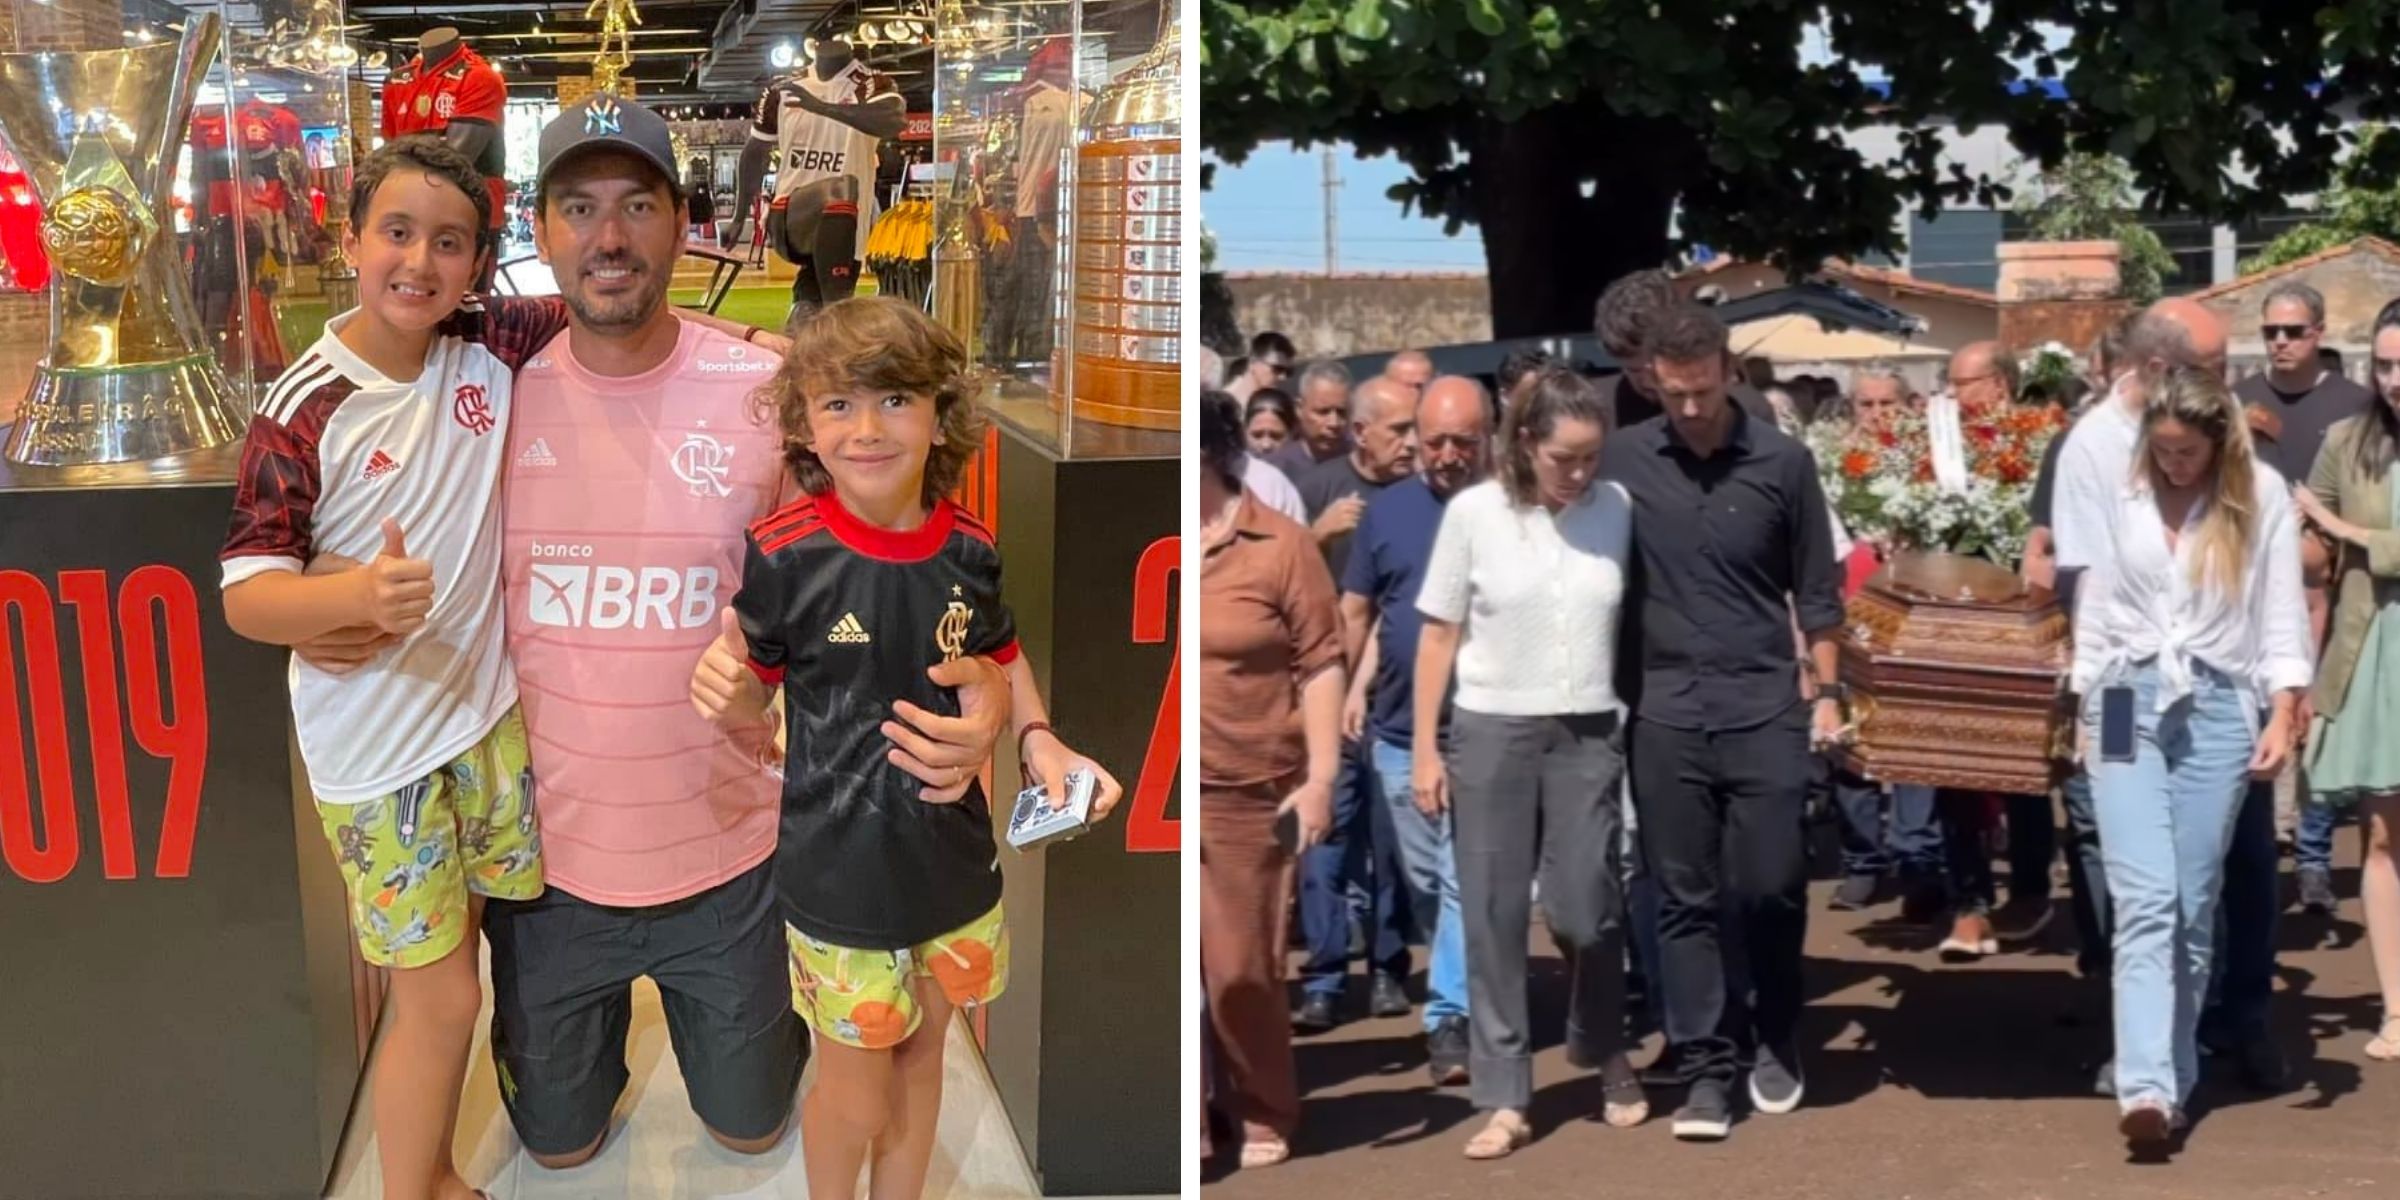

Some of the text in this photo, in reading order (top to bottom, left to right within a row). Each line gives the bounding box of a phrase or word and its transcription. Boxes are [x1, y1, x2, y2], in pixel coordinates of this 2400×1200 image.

[909, 119, 933, 133] 202
[531, 540, 593, 557] banco
[589, 565, 719, 630] BRB
[827, 632, 871, 643] adidas
